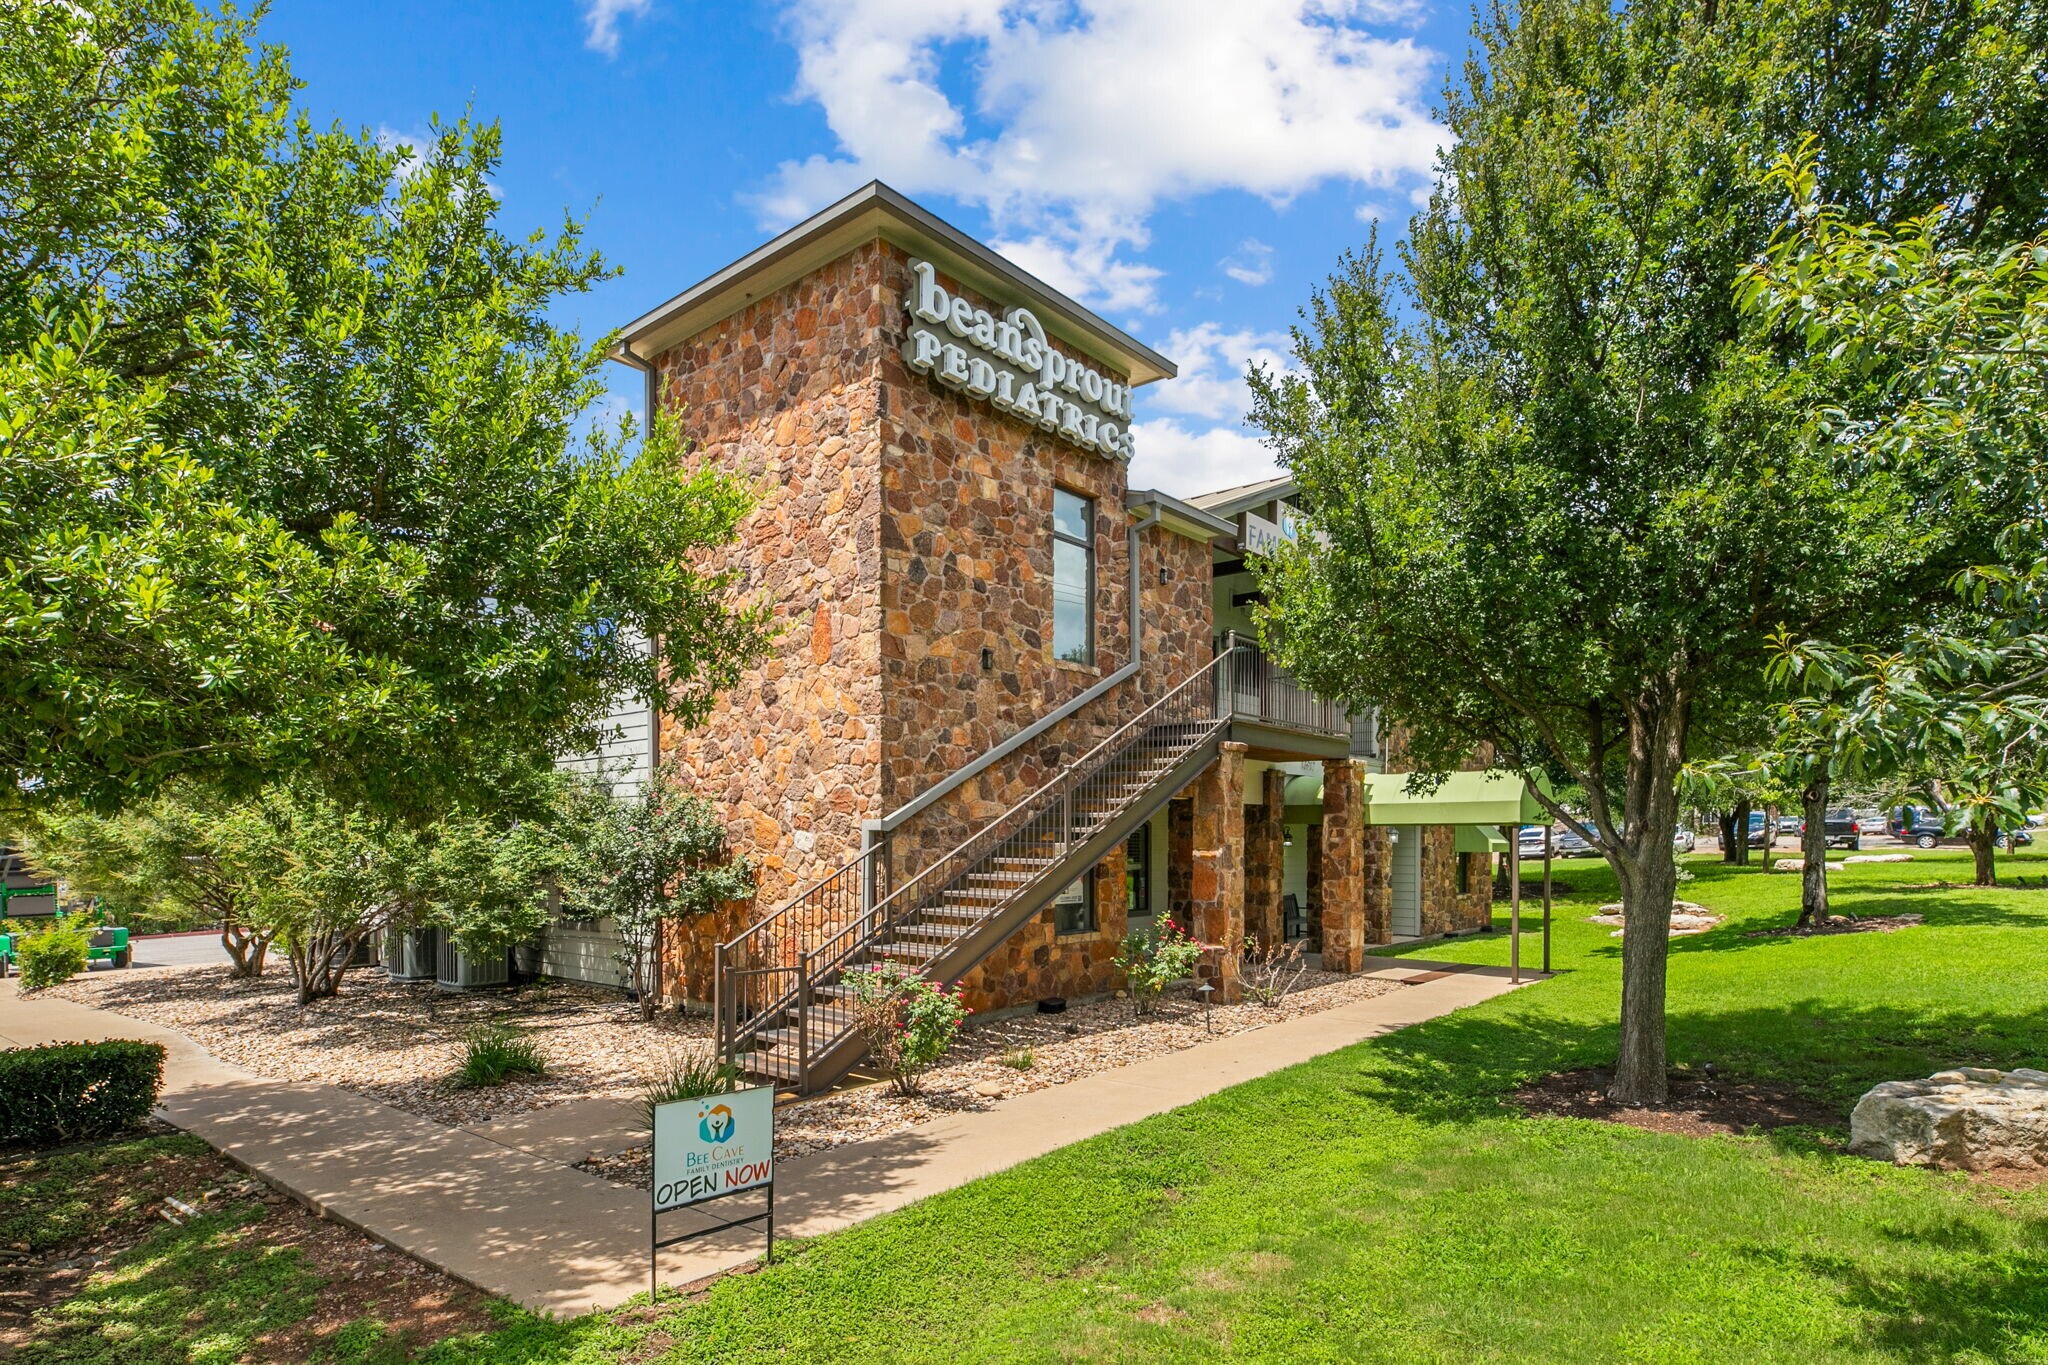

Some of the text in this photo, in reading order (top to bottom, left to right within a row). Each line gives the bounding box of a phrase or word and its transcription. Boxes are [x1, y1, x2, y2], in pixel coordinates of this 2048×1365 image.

[912, 329, 1136, 461] PEDIATRICS
[1249, 525, 1277, 552] FAM
[656, 1159, 771, 1205] OPEN NOW
[687, 1158, 744, 1175] FAMILY DENTISTRY
